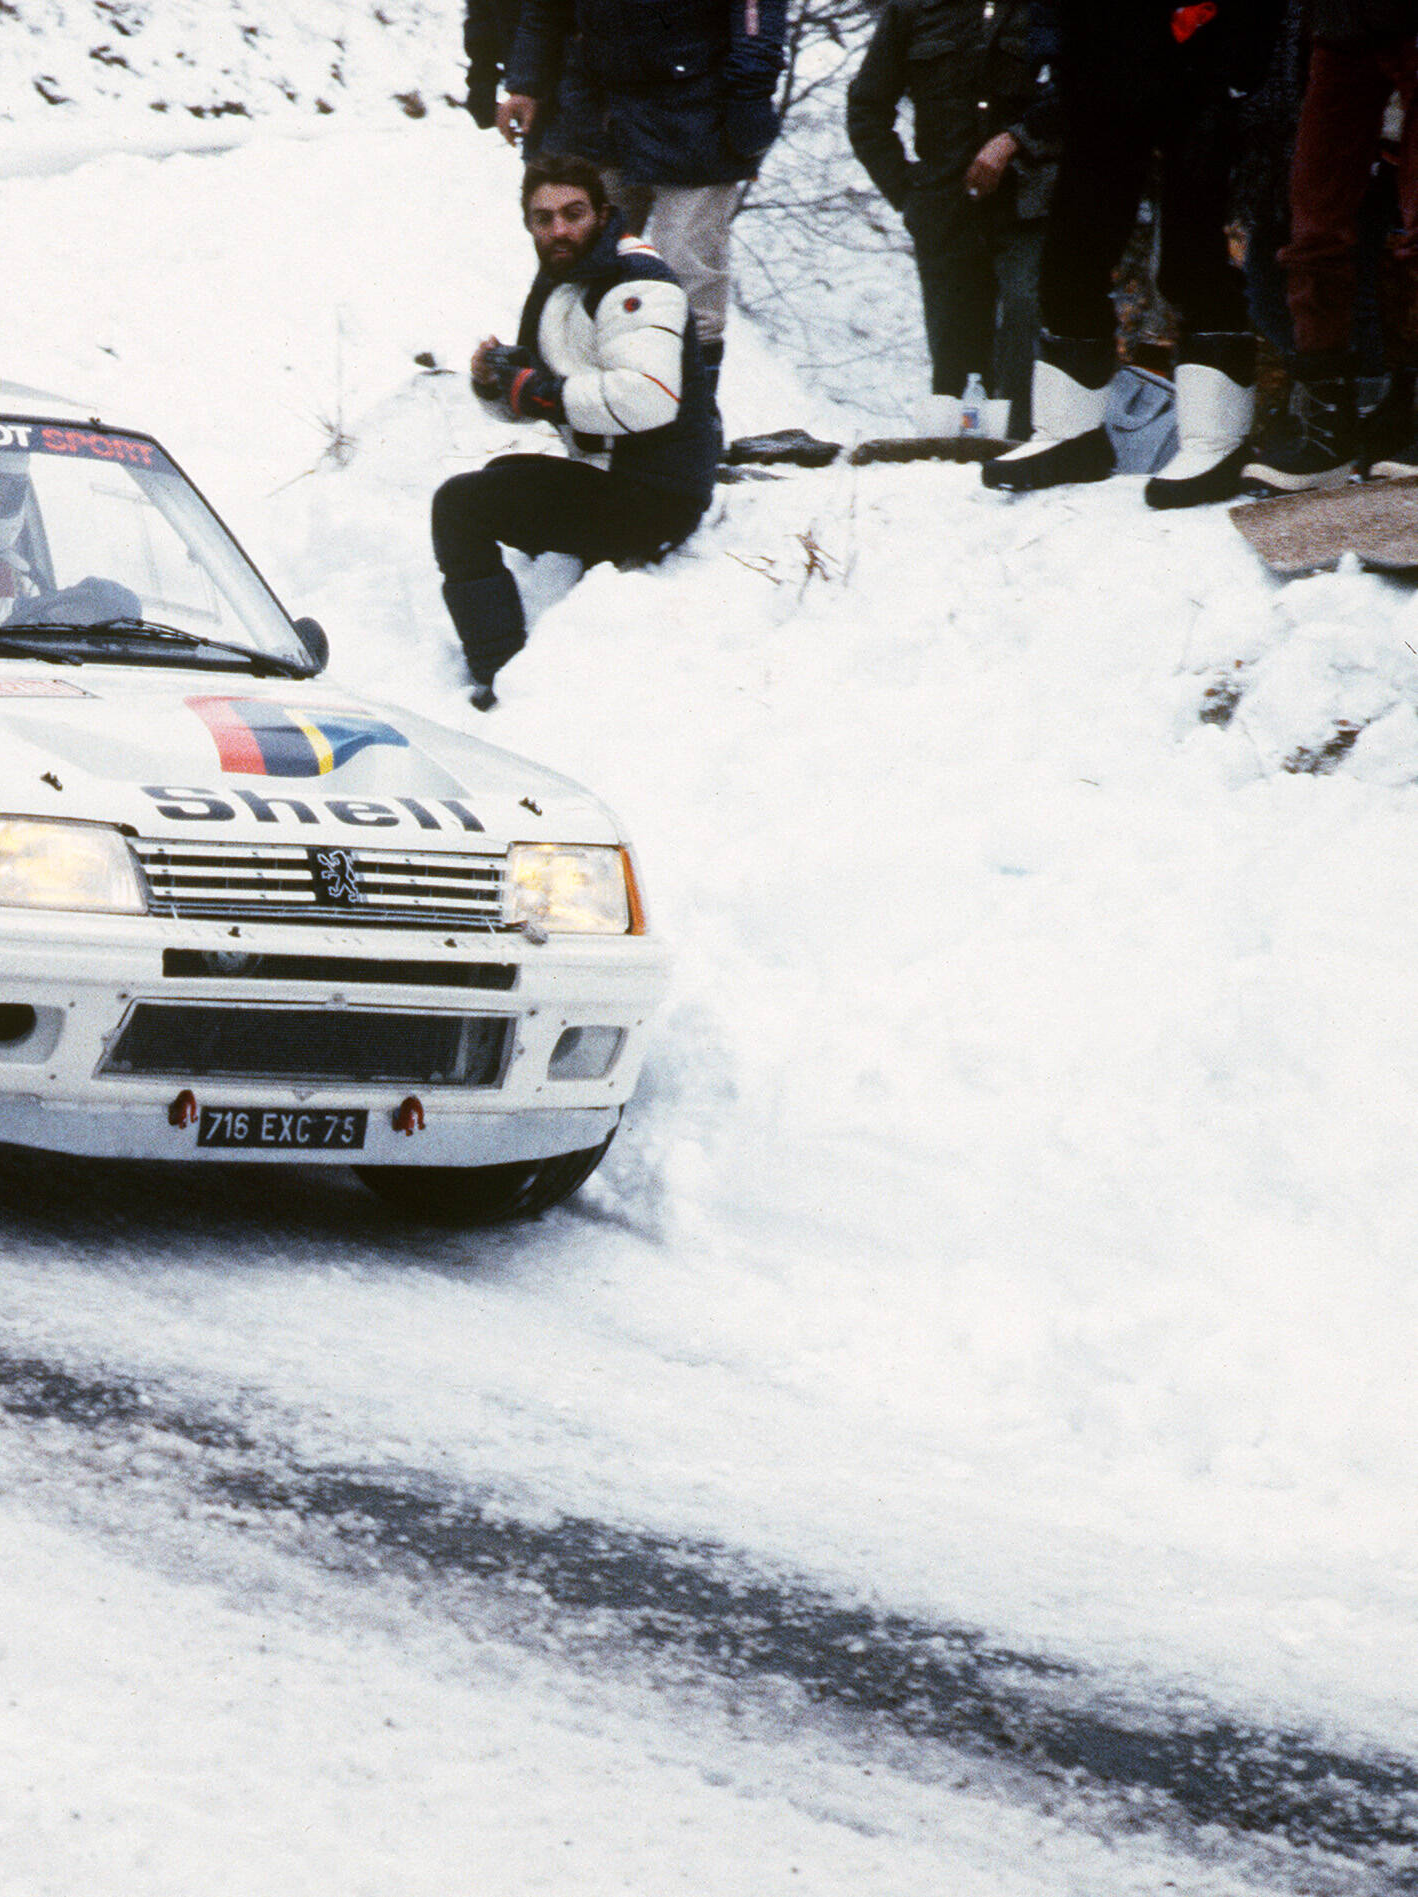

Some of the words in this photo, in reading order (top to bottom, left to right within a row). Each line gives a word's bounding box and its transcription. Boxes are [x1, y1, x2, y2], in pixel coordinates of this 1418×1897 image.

[42, 428, 153, 465] SPORT
[140, 786, 486, 833] Shell
[205, 1111, 250, 1140] 716
[261, 1112, 311, 1143] EXC
[322, 1115, 356, 1143] 75
